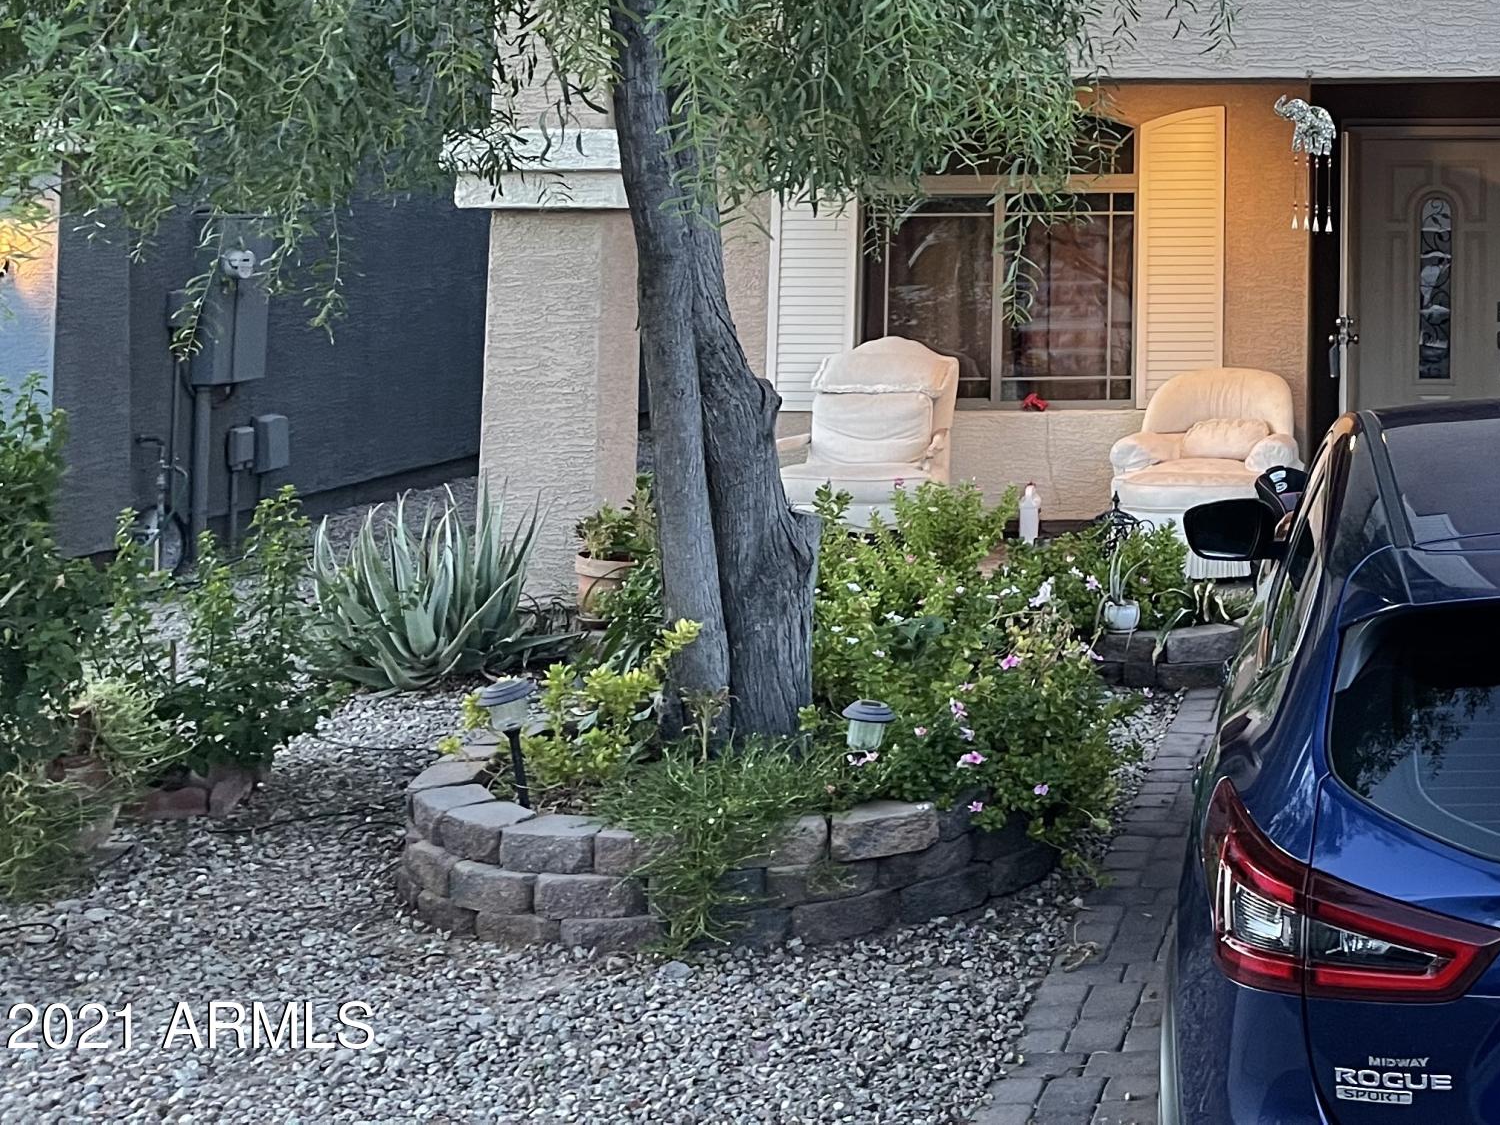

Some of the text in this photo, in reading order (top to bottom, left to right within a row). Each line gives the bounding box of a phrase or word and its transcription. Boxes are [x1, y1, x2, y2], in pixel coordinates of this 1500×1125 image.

[1368, 1056, 1430, 1067] MIDWAY
[1334, 1067, 1453, 1091] ROGUE
[1343, 1088, 1402, 1102] SPORT
